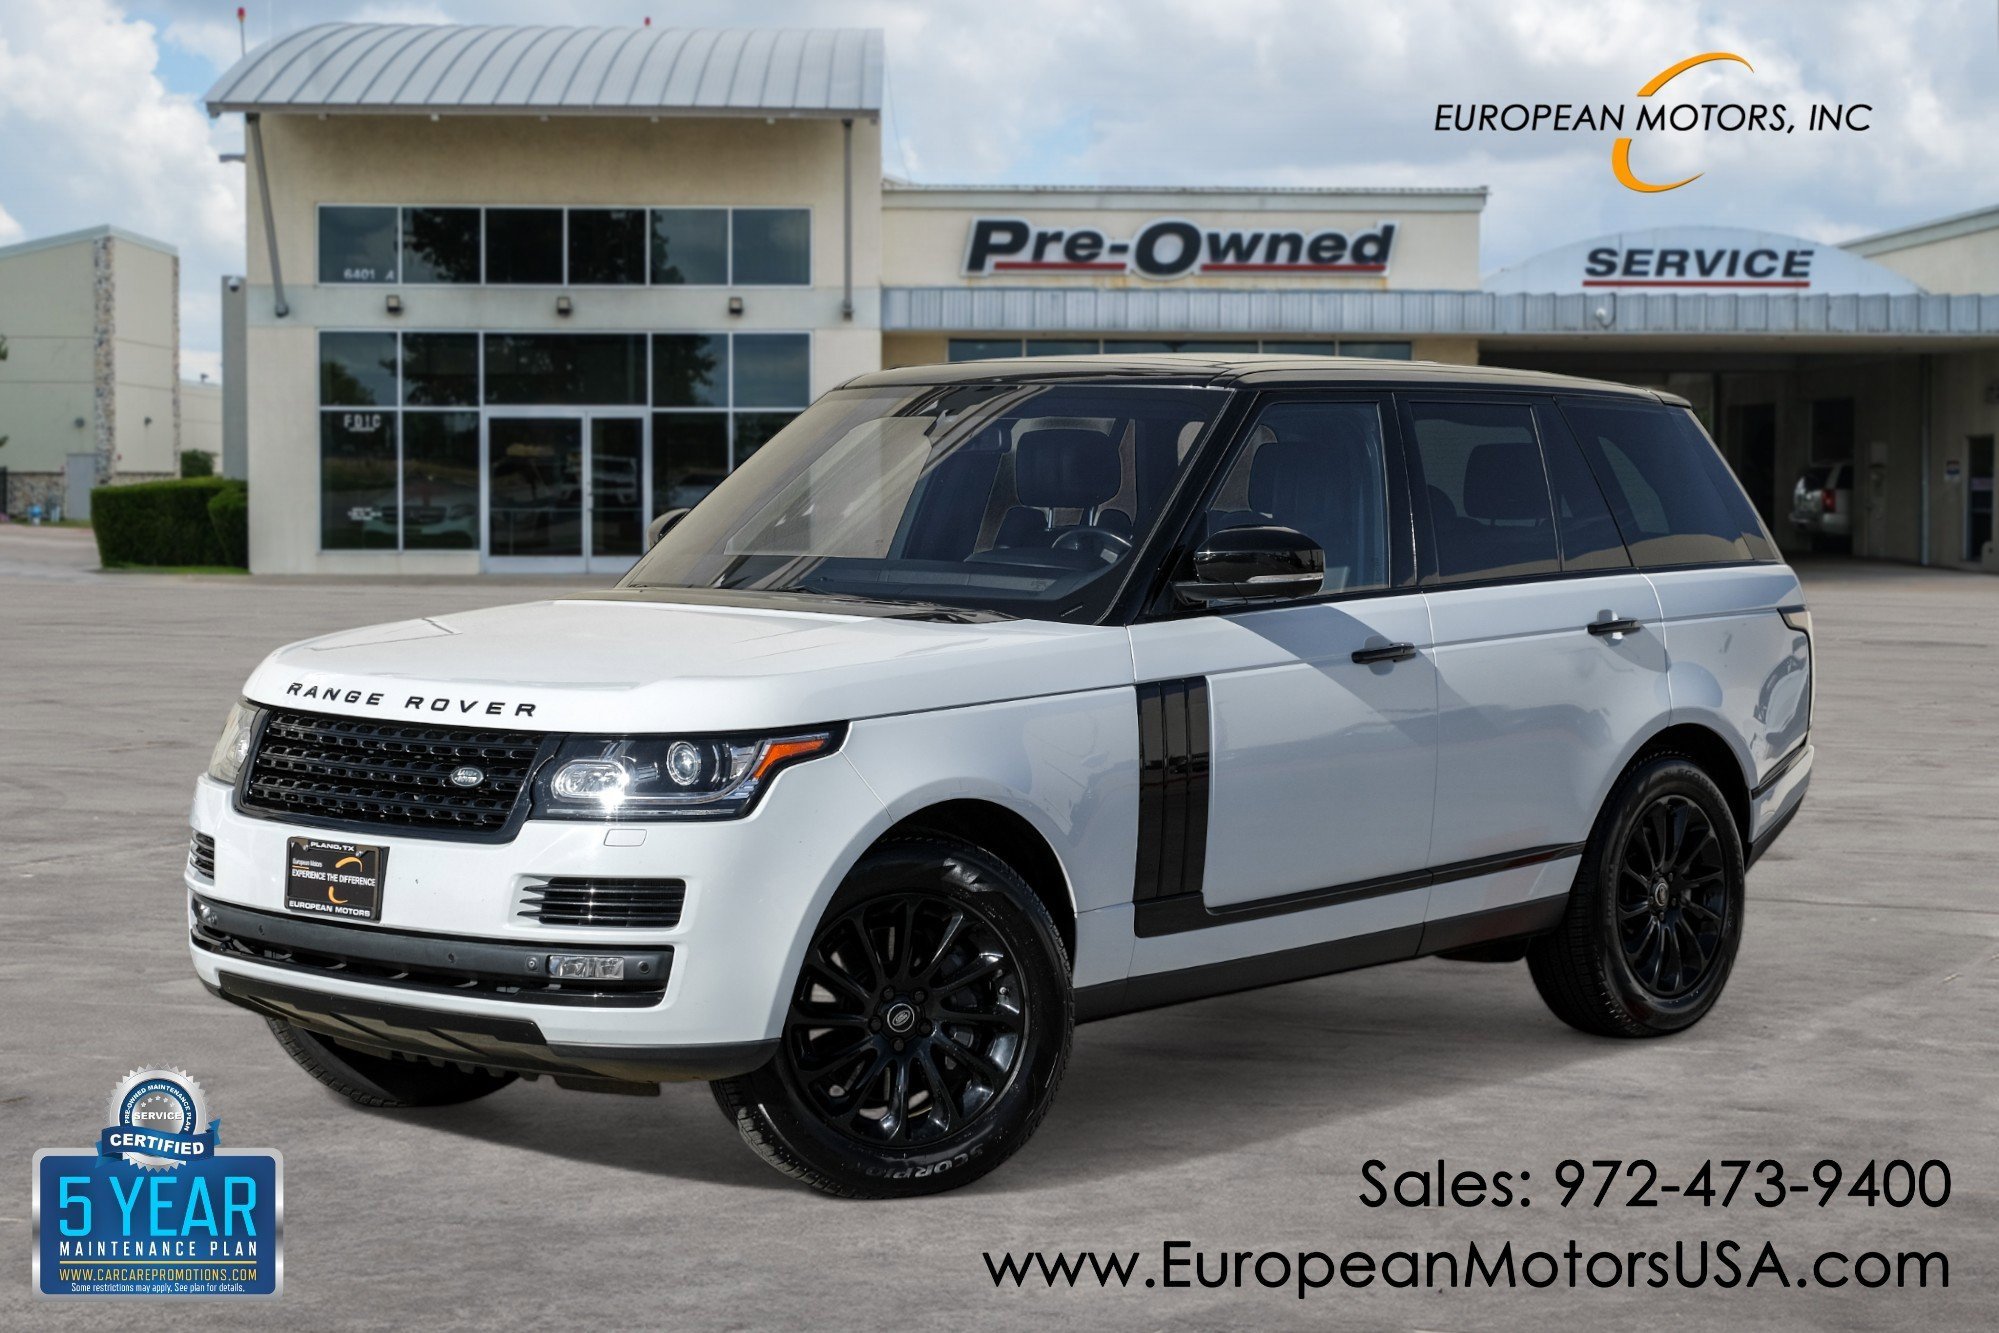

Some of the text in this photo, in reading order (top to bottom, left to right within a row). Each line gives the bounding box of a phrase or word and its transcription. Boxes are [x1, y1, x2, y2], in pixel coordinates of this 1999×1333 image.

[967, 219, 1395, 275] Pre-Owned
[1585, 248, 1814, 278] SERVICE
[286, 682, 536, 717] RANGE ROVER
[292, 869, 376, 887] EXPERIENCE THE DIFFERENCE
[289, 900, 371, 917] EUROPEAN MOTORS
